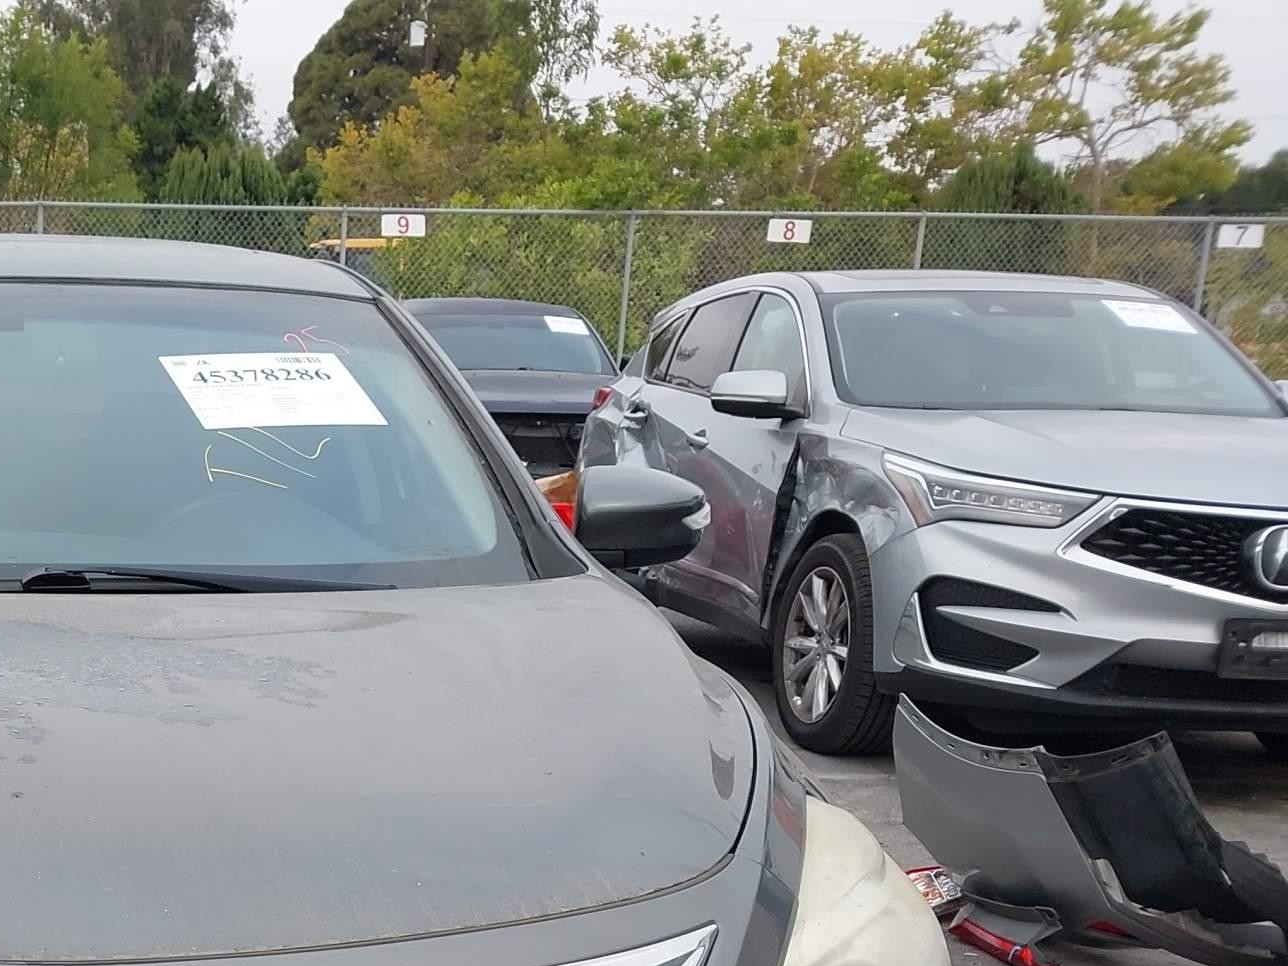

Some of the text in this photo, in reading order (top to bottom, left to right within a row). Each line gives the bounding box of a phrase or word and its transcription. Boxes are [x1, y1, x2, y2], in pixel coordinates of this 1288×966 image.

[397, 215, 409, 234] 9
[783, 220, 796, 240] 8
[1235, 225, 1249, 245] 7
[192, 367, 332, 384] 45378286
